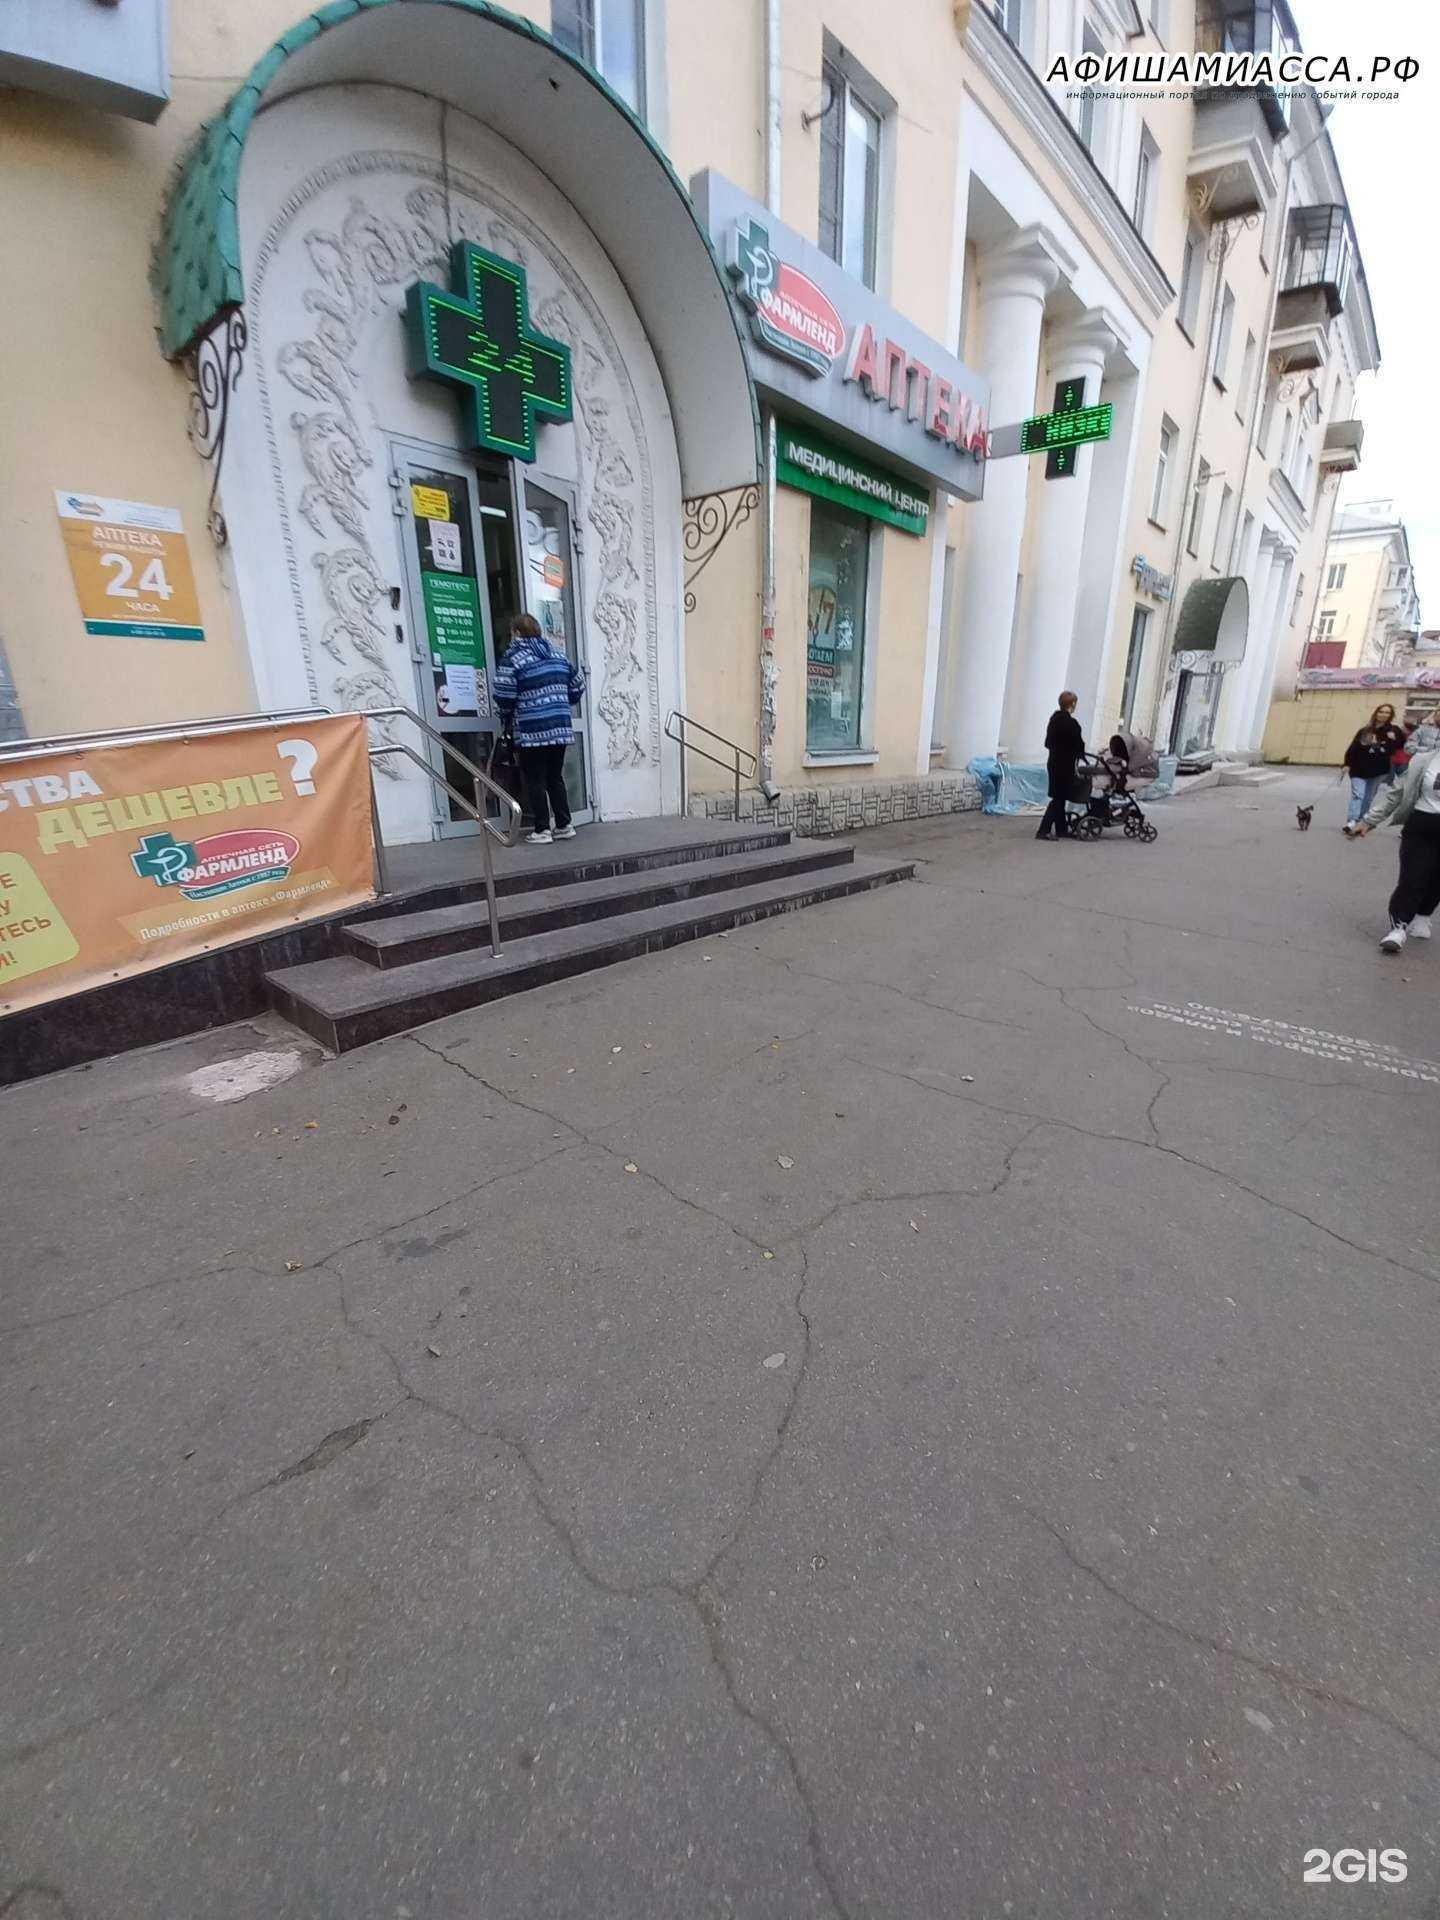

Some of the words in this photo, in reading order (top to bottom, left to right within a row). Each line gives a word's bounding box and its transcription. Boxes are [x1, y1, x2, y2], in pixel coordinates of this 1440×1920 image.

[760, 286, 837, 356] ФАРМЛЕНД
[844, 322, 991, 459] АПТЕКА
[788, 440, 892, 503] МЕДИЦИНСКИЙ
[893, 488, 930, 518] ЦЕНТР
[92, 525, 164, 548] АПТЕКА
[100, 552, 175, 601] 24
[126, 600, 161, 613] ЧАСА
[176, 846, 289, 883] ФАРМЛЕНД
[200, 846, 256, 864] АПТЕЧНАЯ
[257, 841, 285, 852] СЕТЬ
[140, 908, 220, 940] Подробности
[231, 897, 271, 916] аптеке
